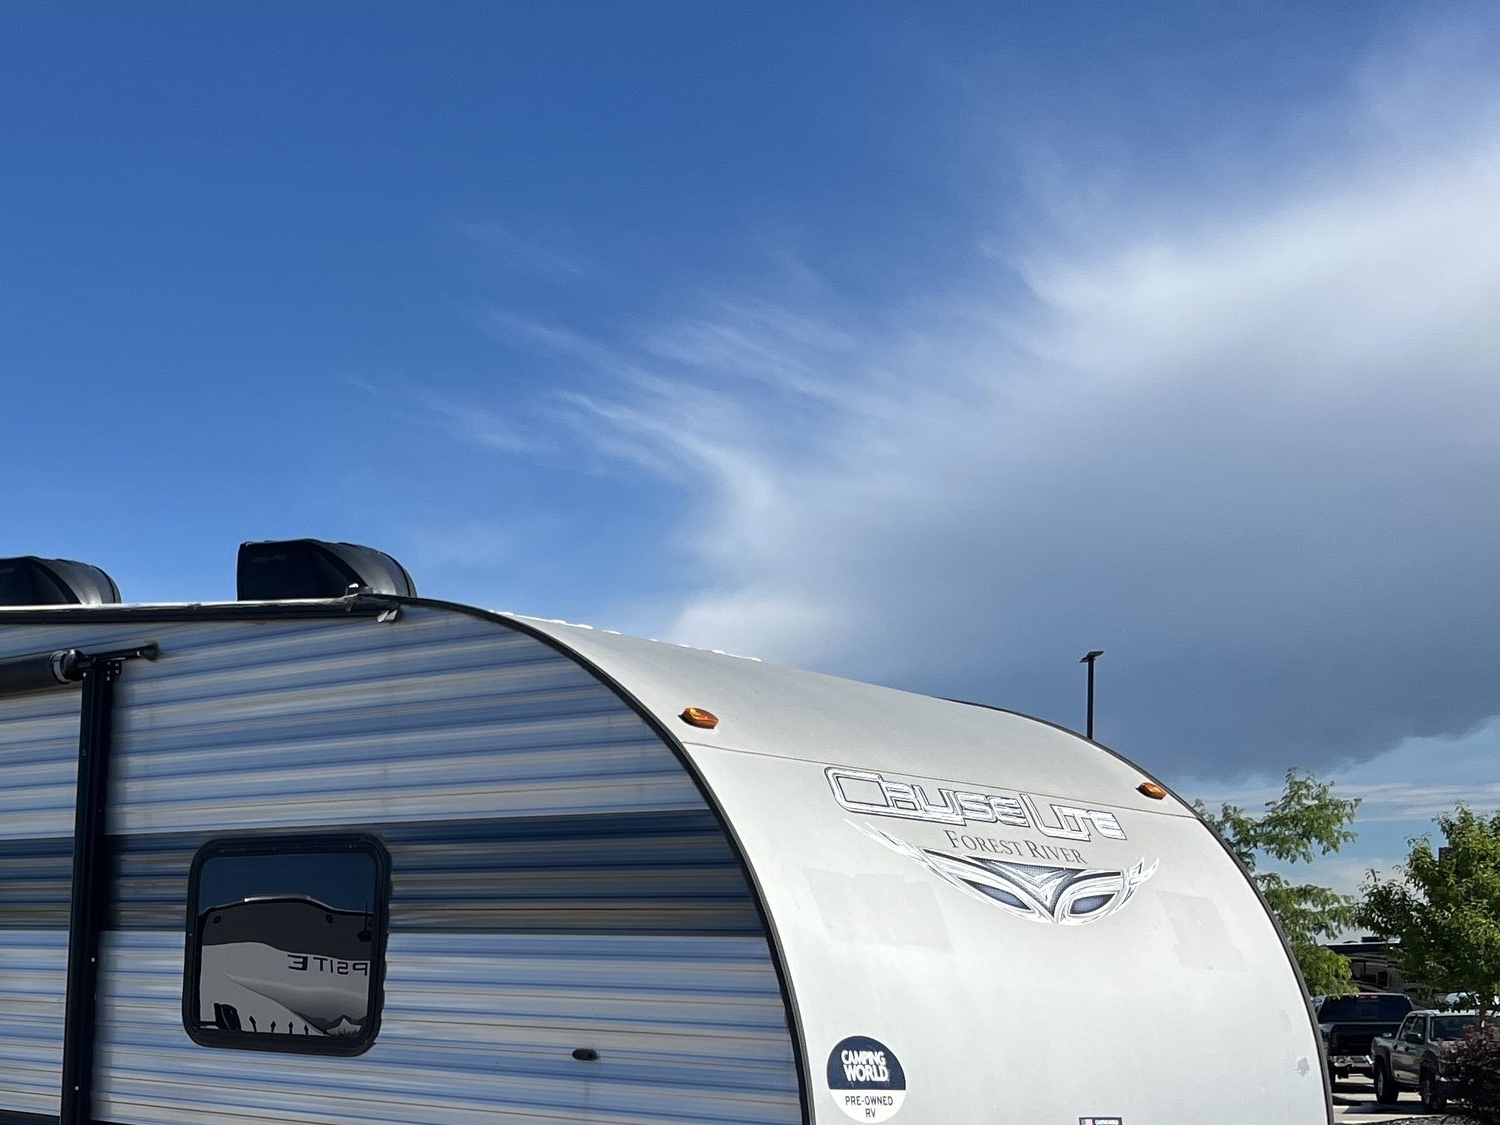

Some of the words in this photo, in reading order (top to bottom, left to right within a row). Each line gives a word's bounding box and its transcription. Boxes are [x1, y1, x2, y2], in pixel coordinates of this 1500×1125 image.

[943, 829, 1022, 858] FOREST
[1024, 839, 1088, 865] RIVER
[841, 1049, 886, 1065] CAMPING
[843, 1064, 889, 1082] WORLD
[845, 1095, 894, 1106] PRE-OWNED
[865, 1108, 876, 1118] RV
